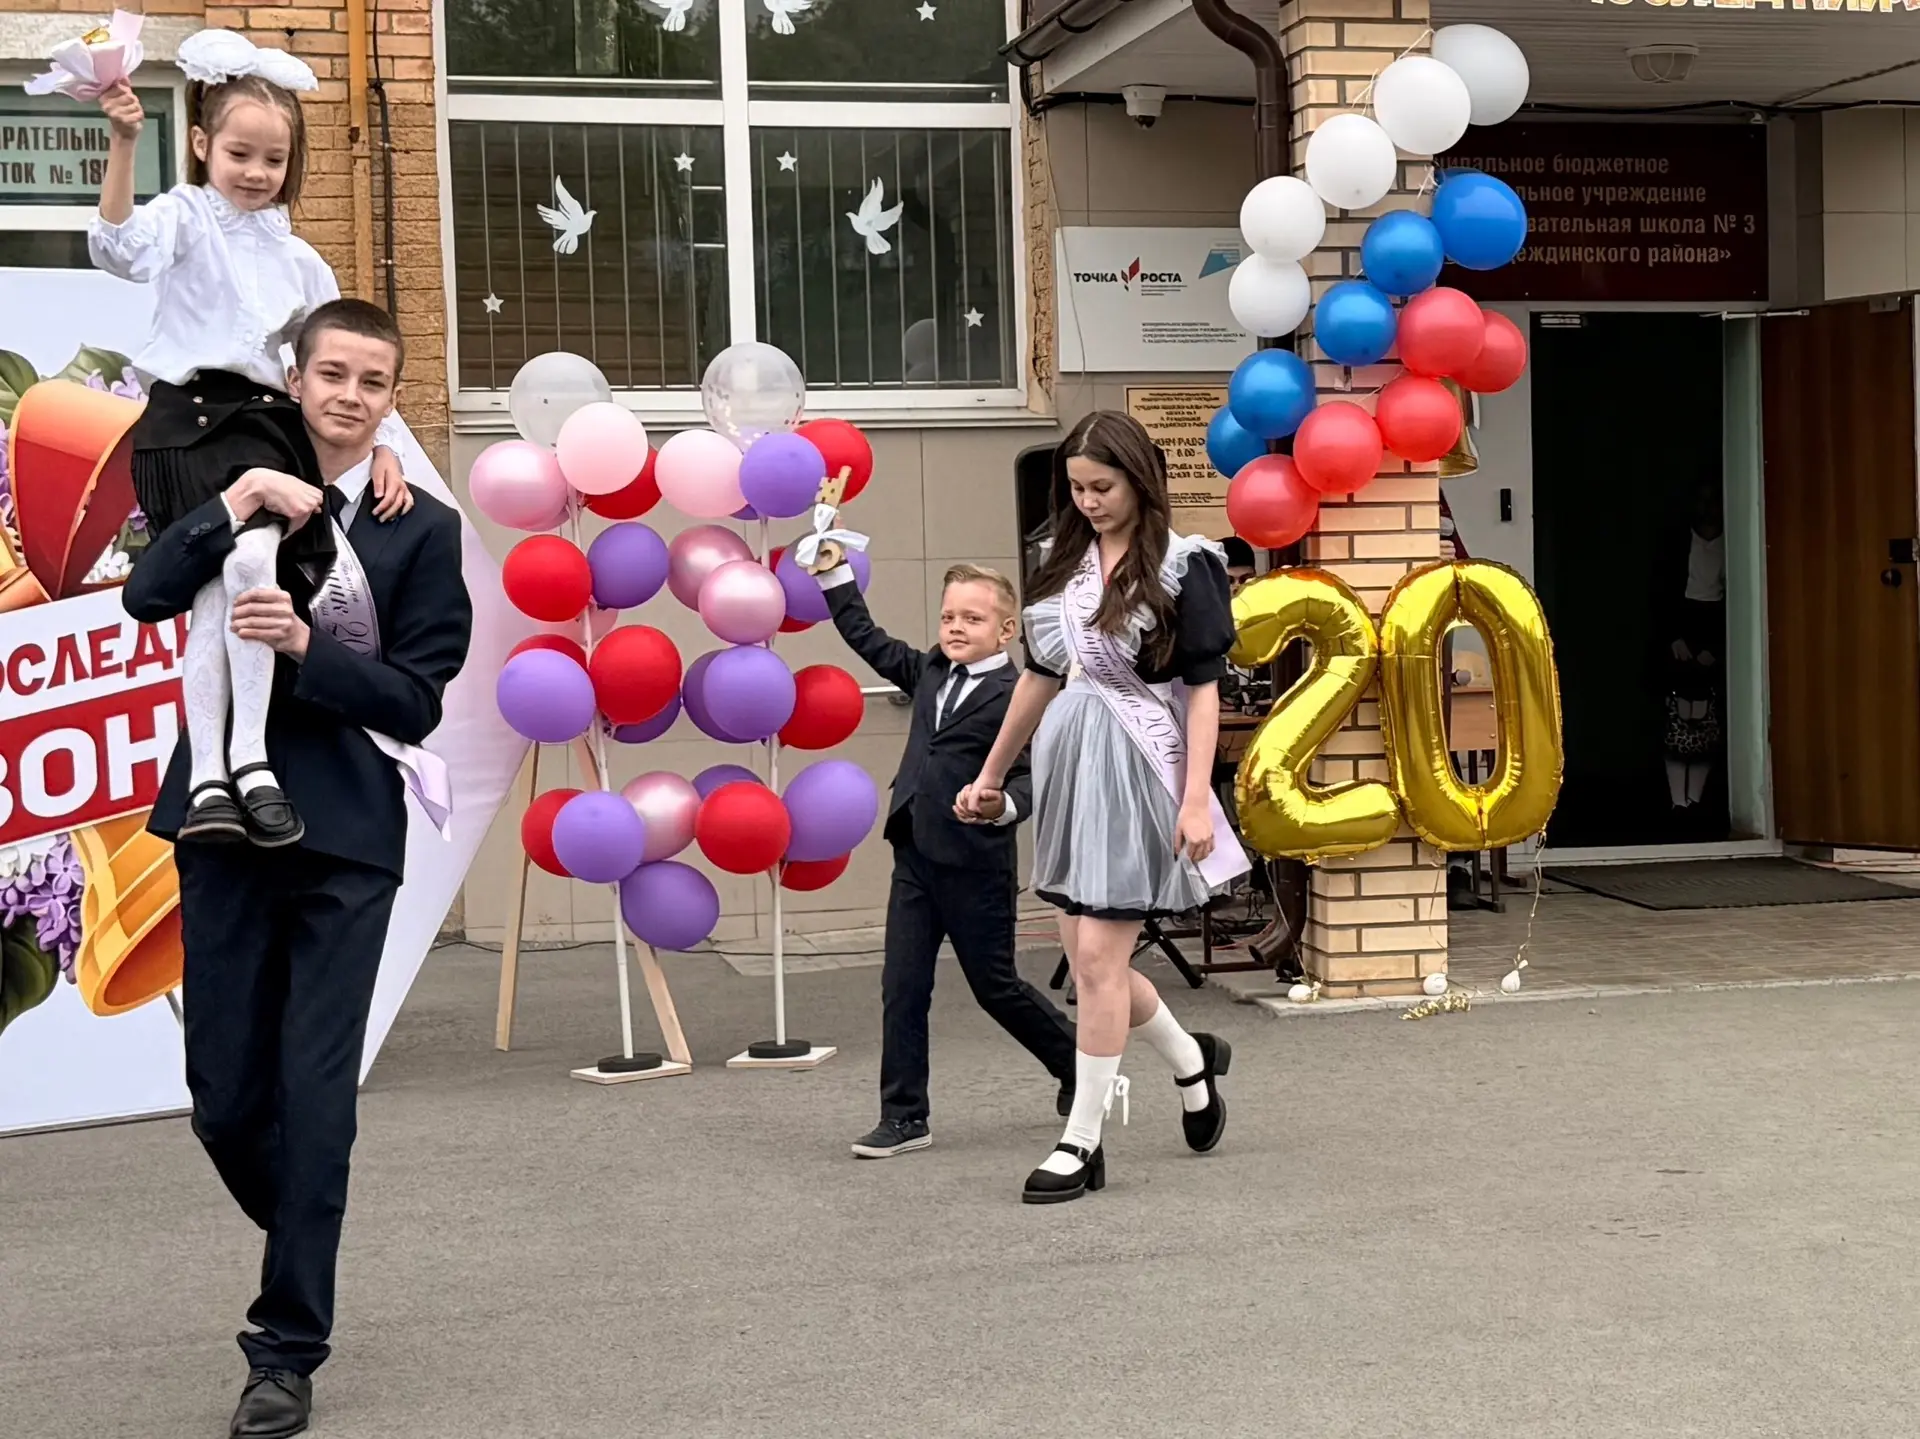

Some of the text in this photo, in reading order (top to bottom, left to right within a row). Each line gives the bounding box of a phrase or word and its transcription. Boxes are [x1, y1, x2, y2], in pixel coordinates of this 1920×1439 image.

[0, 162, 36, 184] ТОК
[79, 159, 109, 185] 18
[1552, 155, 1669, 175] бюджетное
[1514, 185, 1706, 206] льное учреждение
[1527, 215, 1632, 234] вательная
[1639, 215, 1706, 234] школа
[1743, 214, 1756, 234] 3
[1512, 244, 1731, 267] еждинского района»
[1074, 272, 1183, 283] ТОЧКА РОСТА
[1226, 558, 1564, 862] 20
